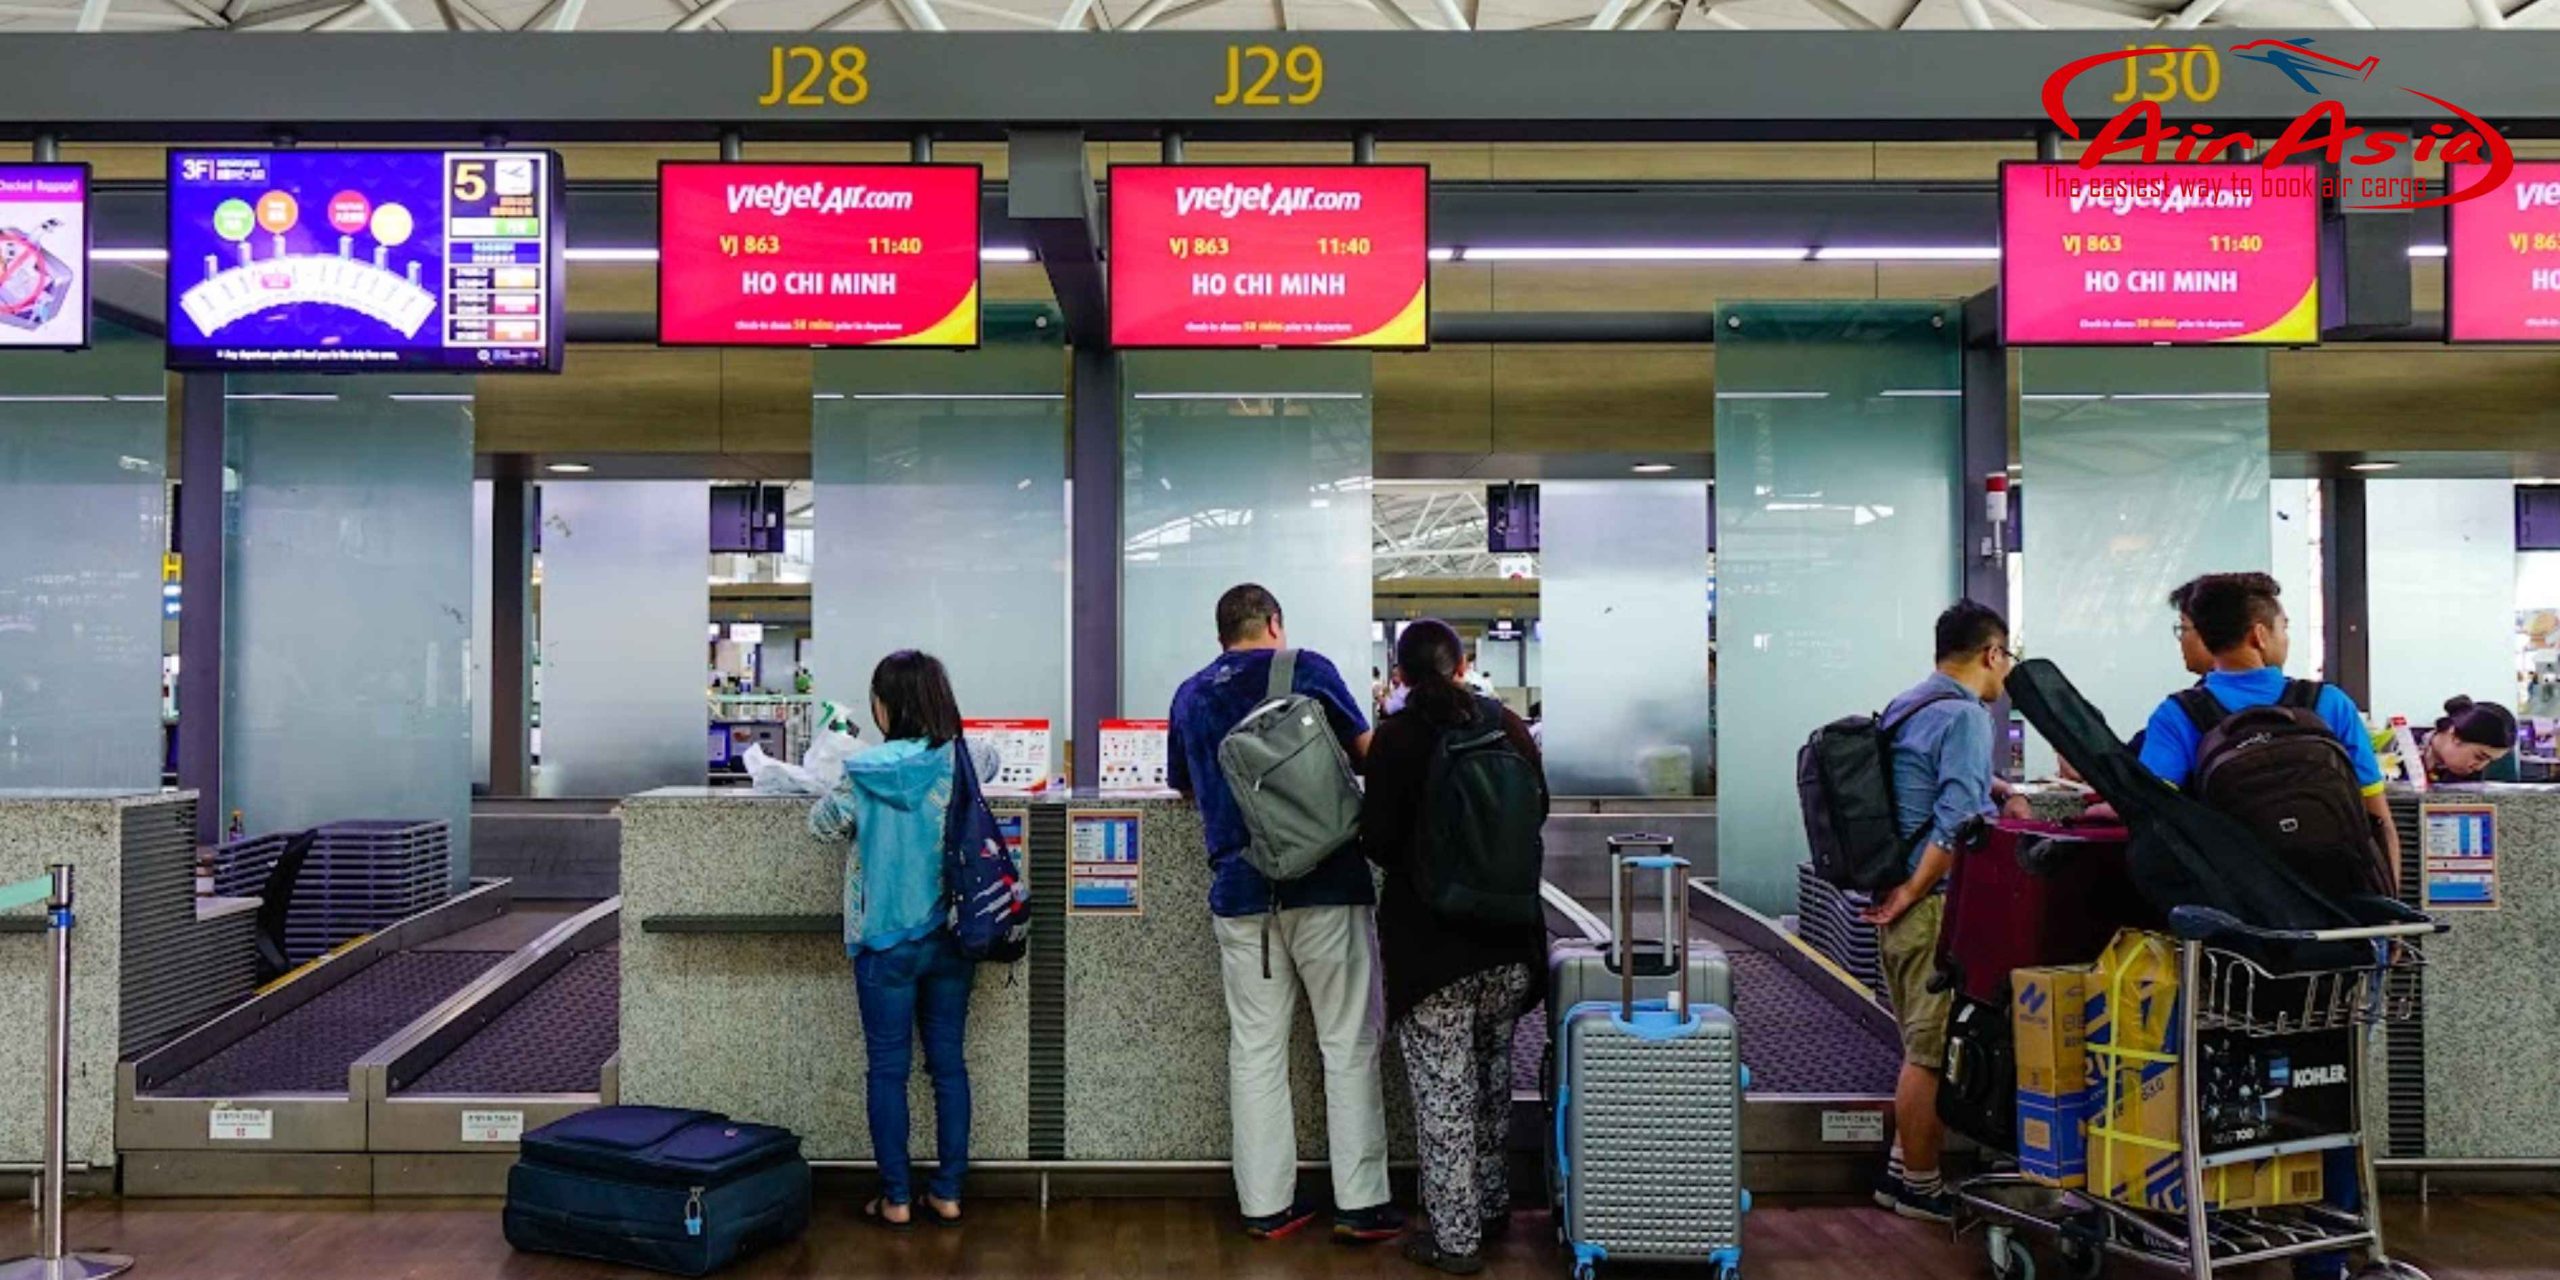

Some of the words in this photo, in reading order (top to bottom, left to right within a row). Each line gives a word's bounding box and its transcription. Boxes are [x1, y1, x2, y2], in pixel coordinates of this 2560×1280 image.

[758, 46, 869, 104] J28
[1214, 45, 1324, 104] J29
[2112, 44, 2221, 103] J30
[182, 158, 208, 180] 3F
[454, 162, 487, 201] 5
[719, 235, 739, 256] VJ
[744, 235, 781, 253] 863
[867, 237, 923, 254] 11:40
[1169, 237, 1188, 258] VJ
[1194, 237, 1230, 254] 863
[1317, 238, 1371, 254] 11:40
[2062, 234, 2082, 255] VJ
[2086, 234, 2123, 252] 863
[2208, 234, 2263, 252] 11:40
[2508, 232, 2528, 254] VJ
[741, 272, 777, 295] HO
[784, 272, 823, 295] CHI
[831, 272, 896, 295] MINH
[1191, 273, 1227, 295] HO
[1233, 273, 1272, 295] CHI
[1280, 273, 1346, 295] MINH
[2084, 271, 2119, 293] HO
[2126, 271, 2165, 293] CHI
[2173, 271, 2238, 293] MINH
[163, 551, 183, 582] H
[2292, 1063, 2347, 1089] KOHLER
